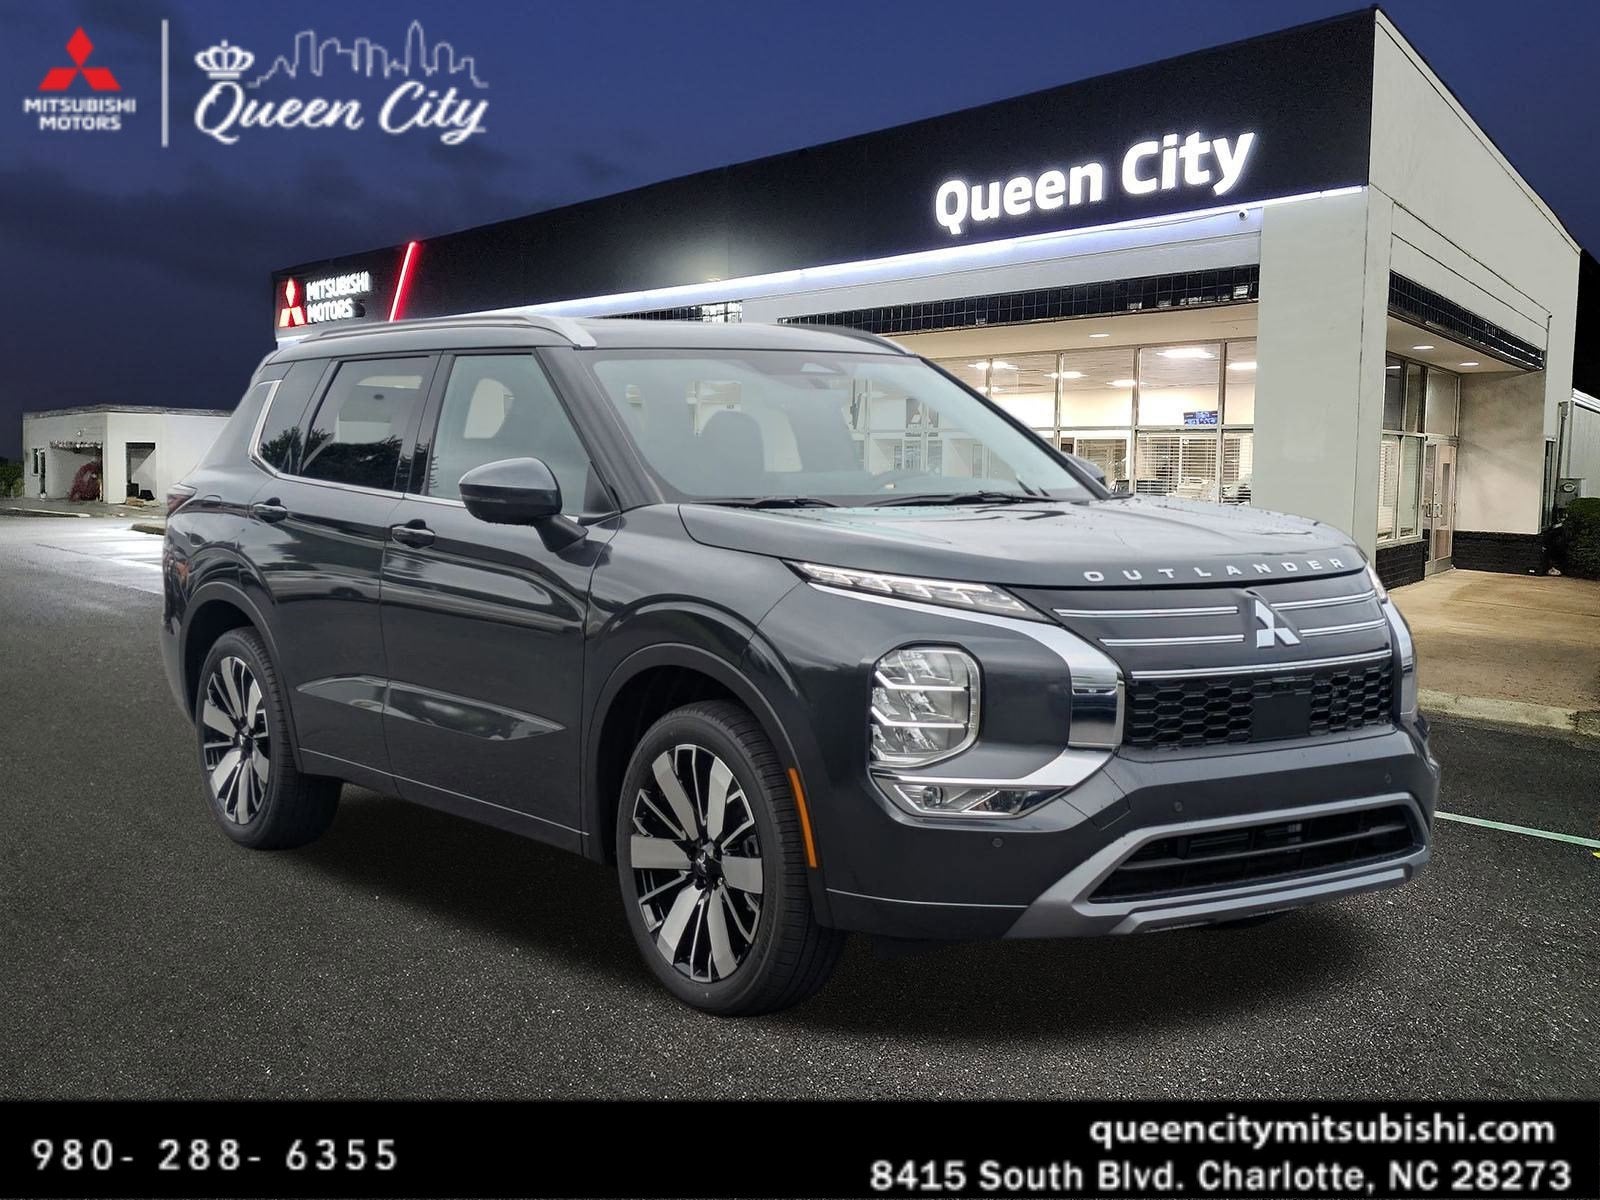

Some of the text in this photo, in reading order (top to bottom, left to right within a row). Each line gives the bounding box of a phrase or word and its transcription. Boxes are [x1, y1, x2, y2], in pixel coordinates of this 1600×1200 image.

[935, 131, 1255, 234] Queen City
[306, 270, 370, 302] MITSUBISHI
[307, 298, 354, 324] MOTORS
[1083, 558, 1345, 582] OUTLANDER
